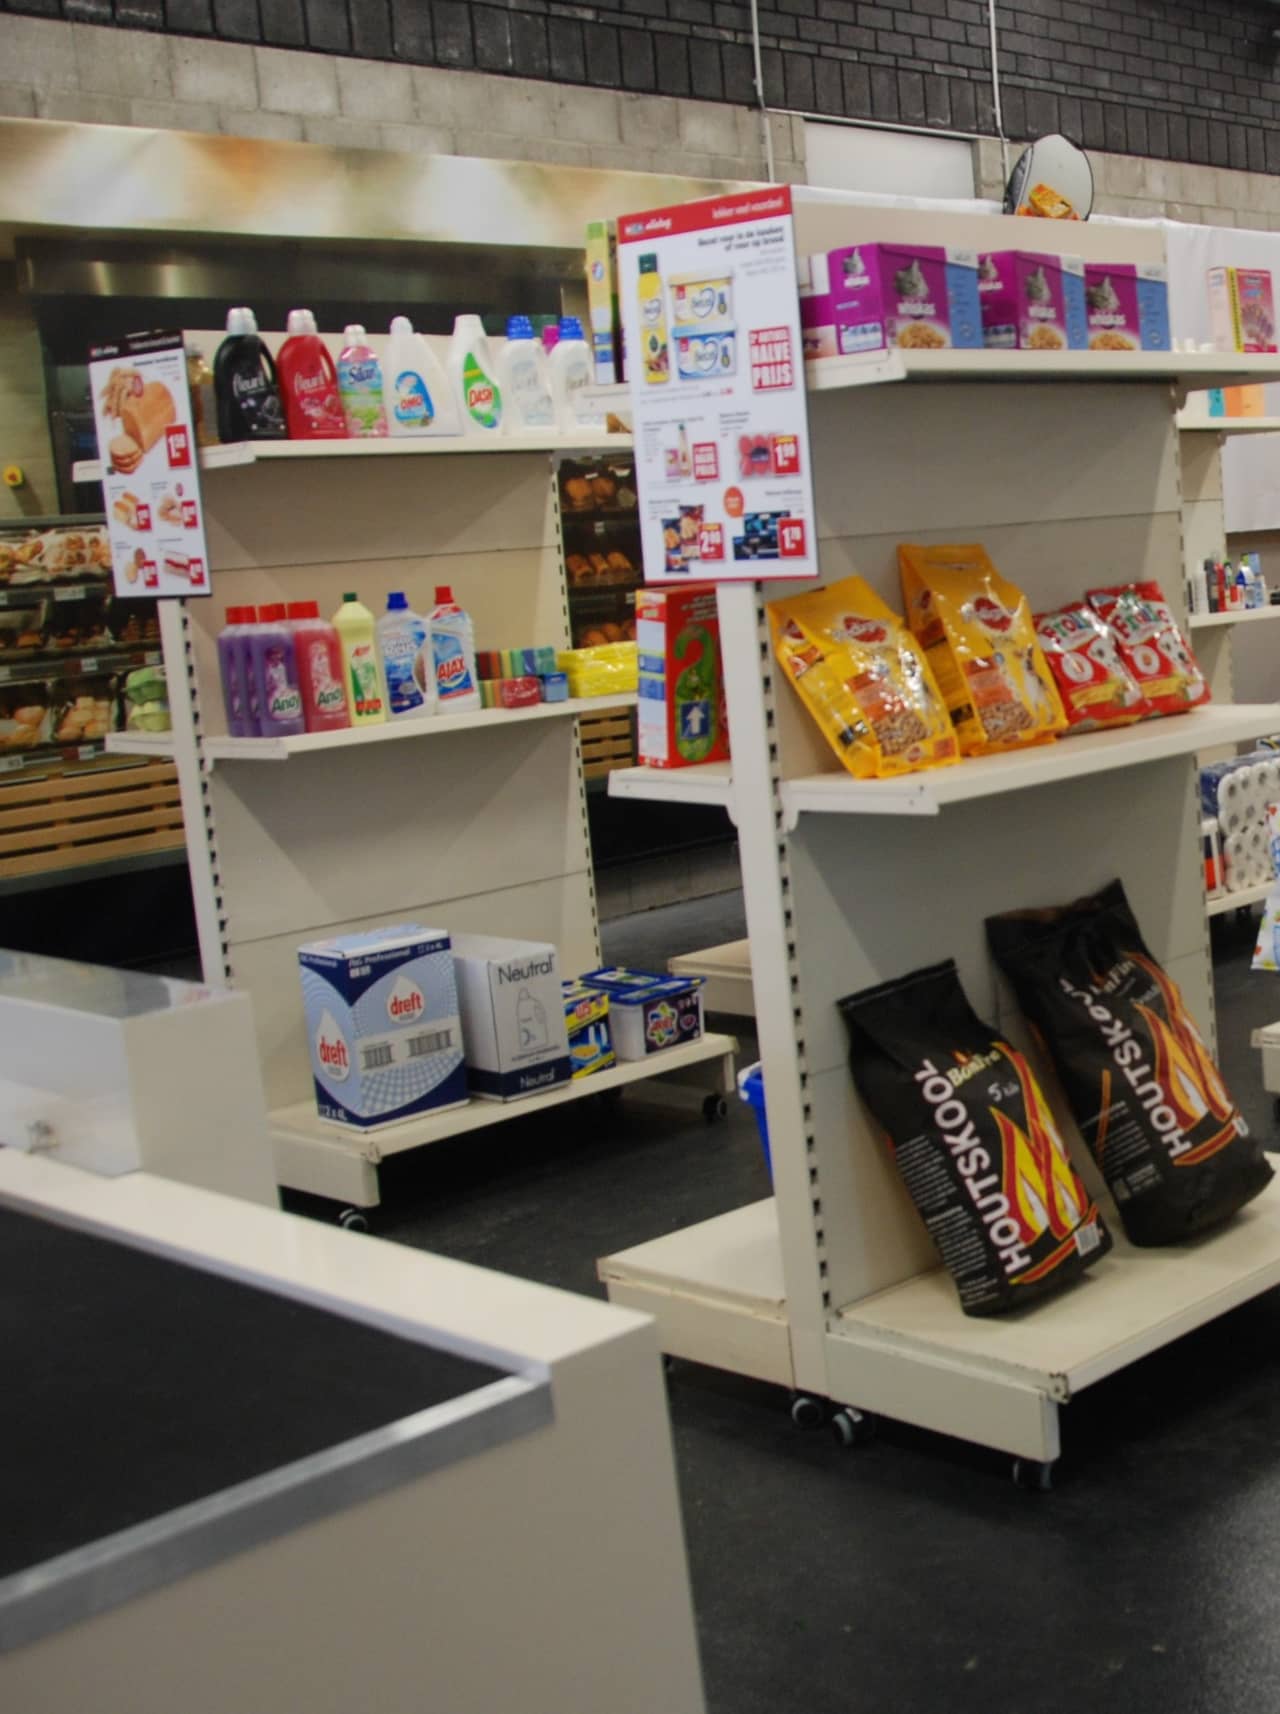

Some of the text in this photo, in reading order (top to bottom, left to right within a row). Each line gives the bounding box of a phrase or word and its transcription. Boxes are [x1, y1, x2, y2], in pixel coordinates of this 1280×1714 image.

[437, 655, 466, 681] AJAX
[498, 953, 553, 985] Neutral
[390, 992, 422, 1016] dreft
[320, 1035, 348, 1068] dreft
[912, 1057, 1033, 1275] HOUTSKOOL
